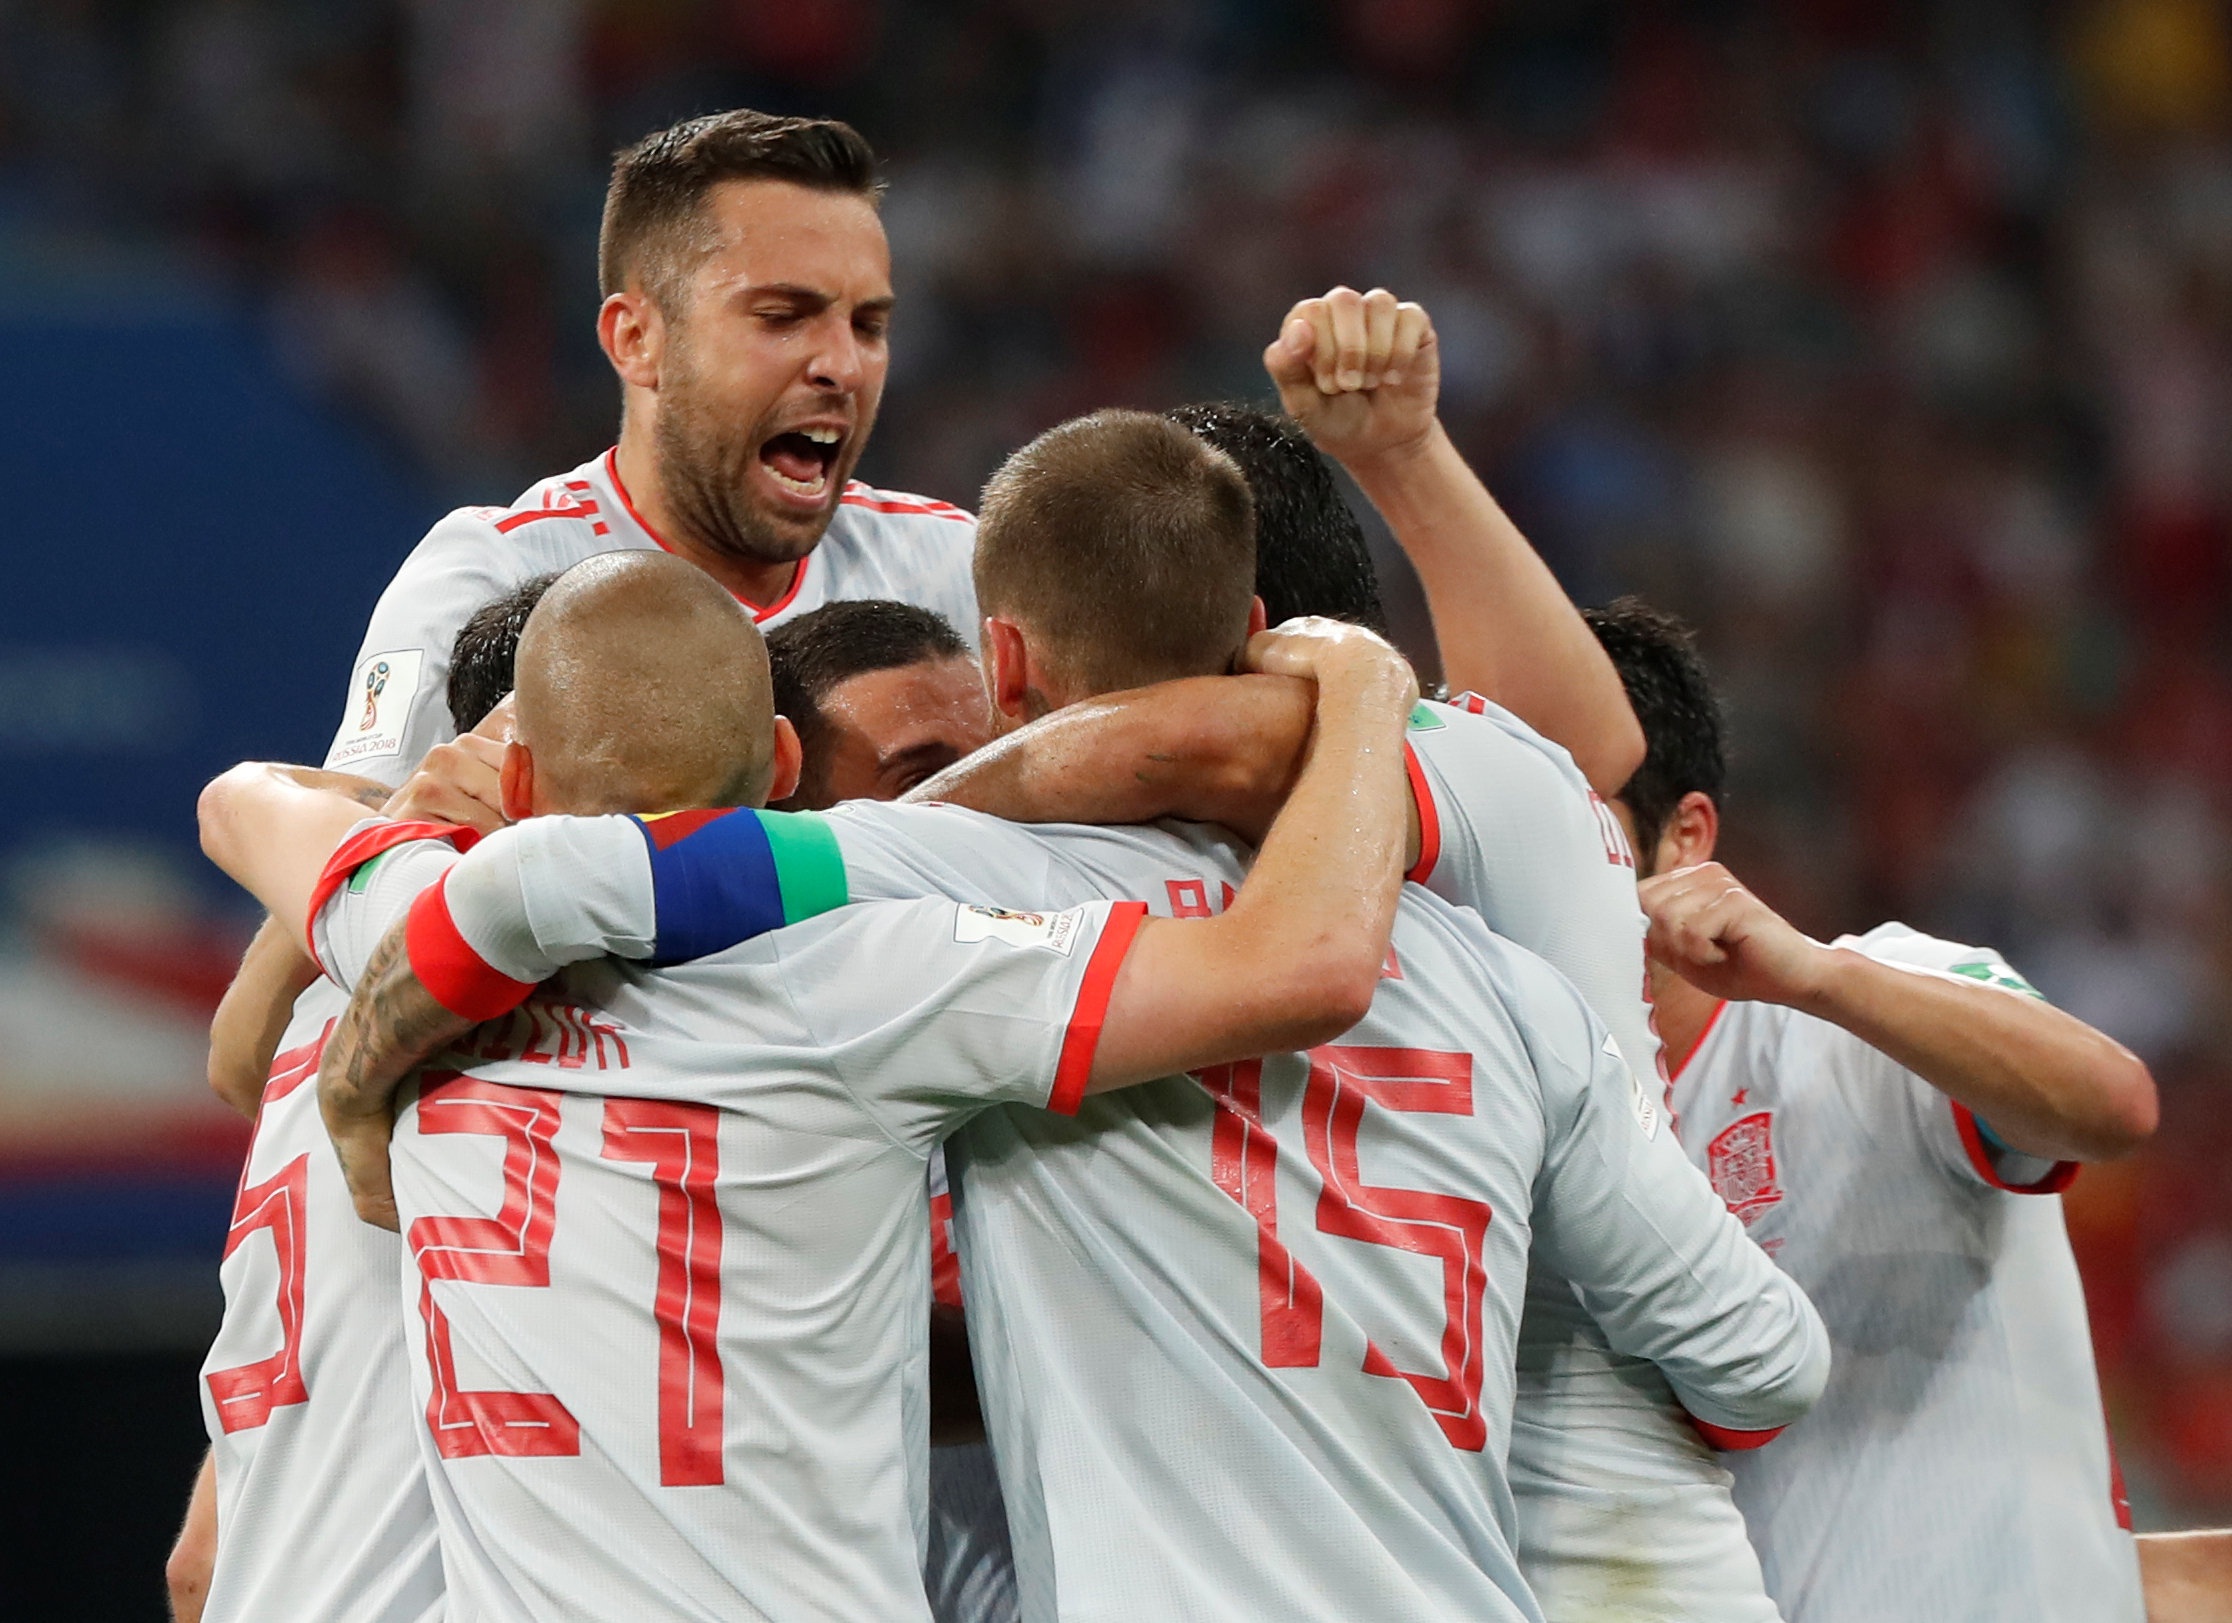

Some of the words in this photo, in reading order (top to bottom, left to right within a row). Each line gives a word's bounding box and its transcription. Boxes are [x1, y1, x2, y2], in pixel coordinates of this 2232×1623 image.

[369, 737, 397, 752] 2018
[206, 1016, 337, 1436] 5
[407, 1069, 725, 1487] 21
[1186, 1044, 1493, 1453] 15
